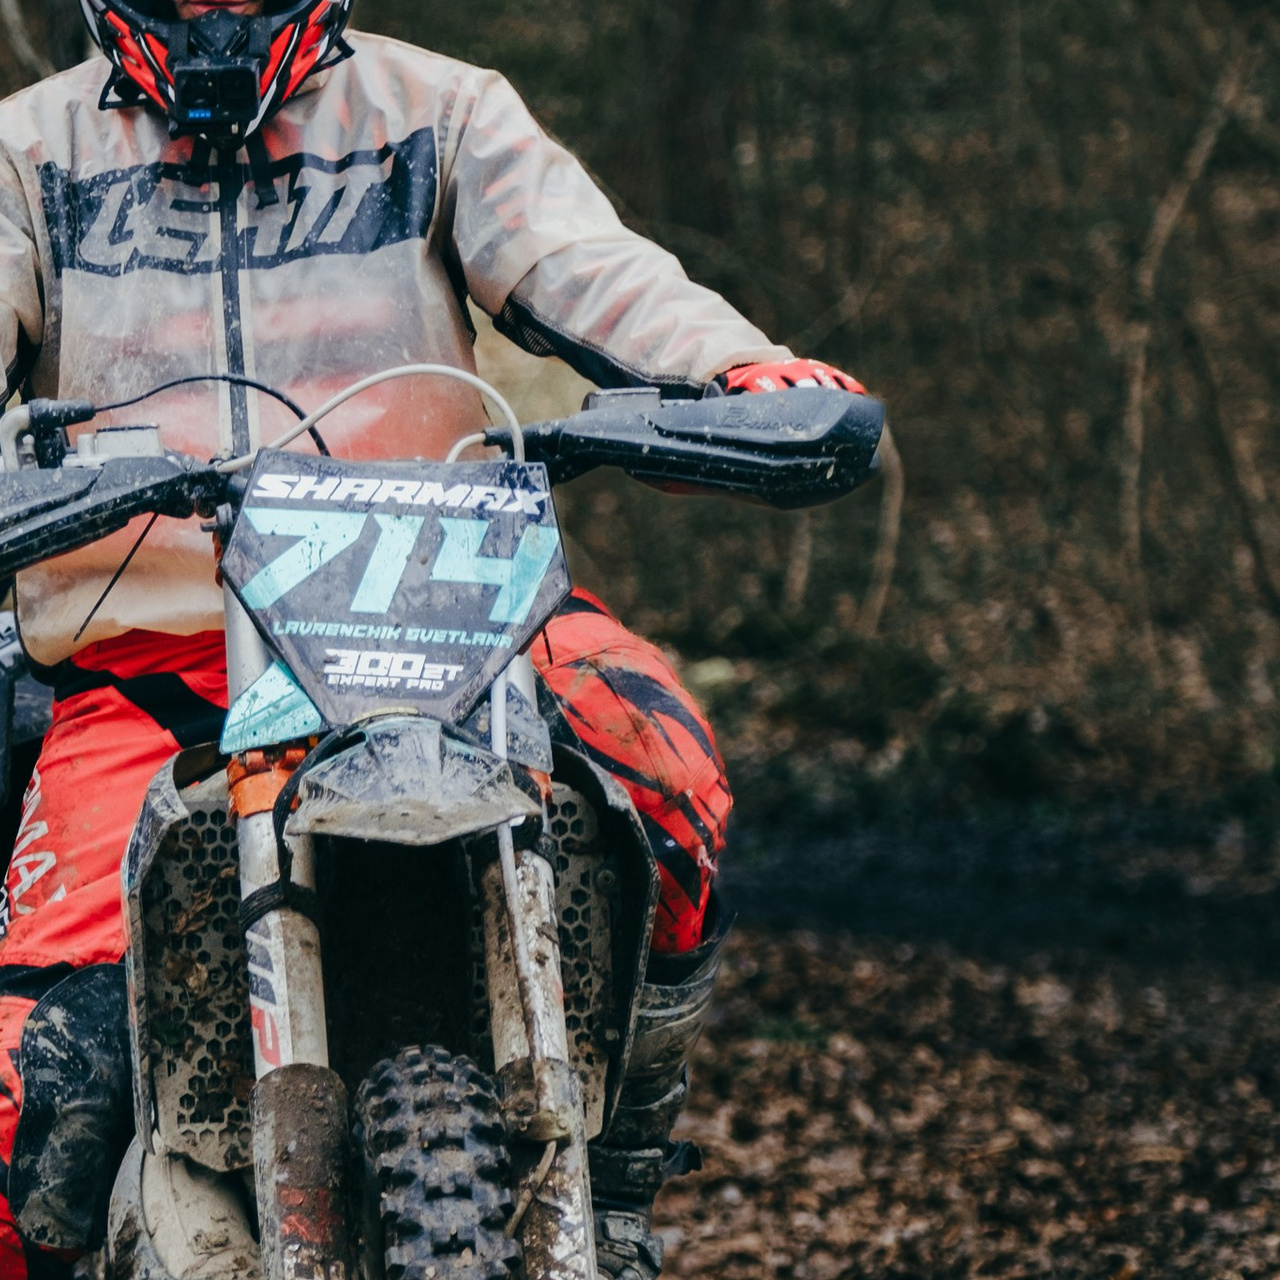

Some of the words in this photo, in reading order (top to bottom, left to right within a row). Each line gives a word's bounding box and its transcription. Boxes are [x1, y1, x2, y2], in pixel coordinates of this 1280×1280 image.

[252, 474, 549, 515] SHARMAX
[241, 507, 559, 624] 714
[272, 620, 402, 640] LAVRENCHIK
[404, 627, 514, 649] SVETLANA
[327, 675, 401, 687] EXPERT
[406, 679, 445, 692] PRO
